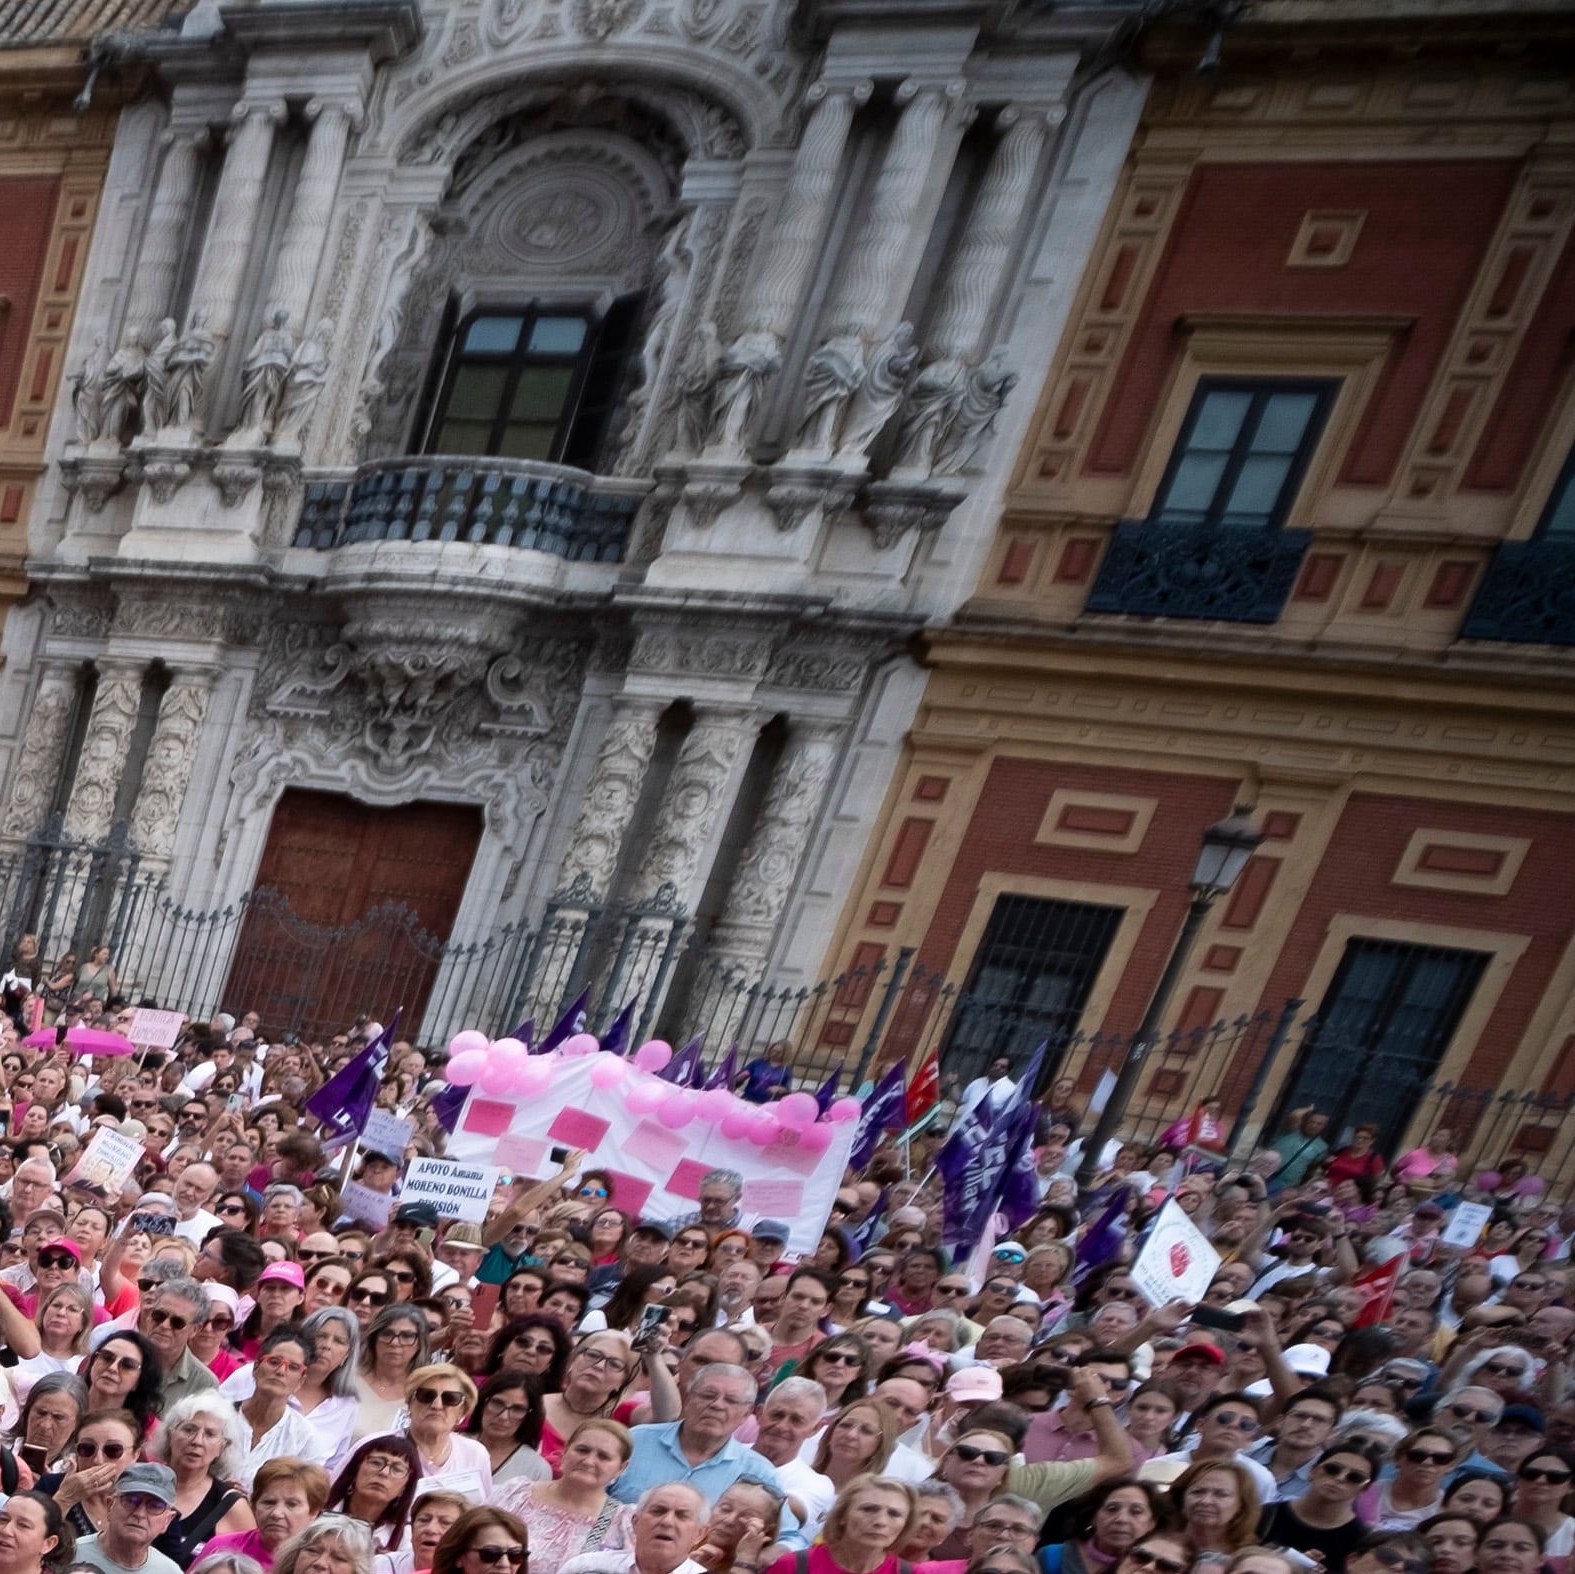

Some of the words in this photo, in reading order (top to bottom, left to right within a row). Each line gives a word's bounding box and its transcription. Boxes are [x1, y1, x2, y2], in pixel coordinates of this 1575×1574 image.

[417, 1162, 449, 1178] APOYO
[406, 1179, 447, 1194] MORENO
[447, 1183, 488, 1200] BONILLA
